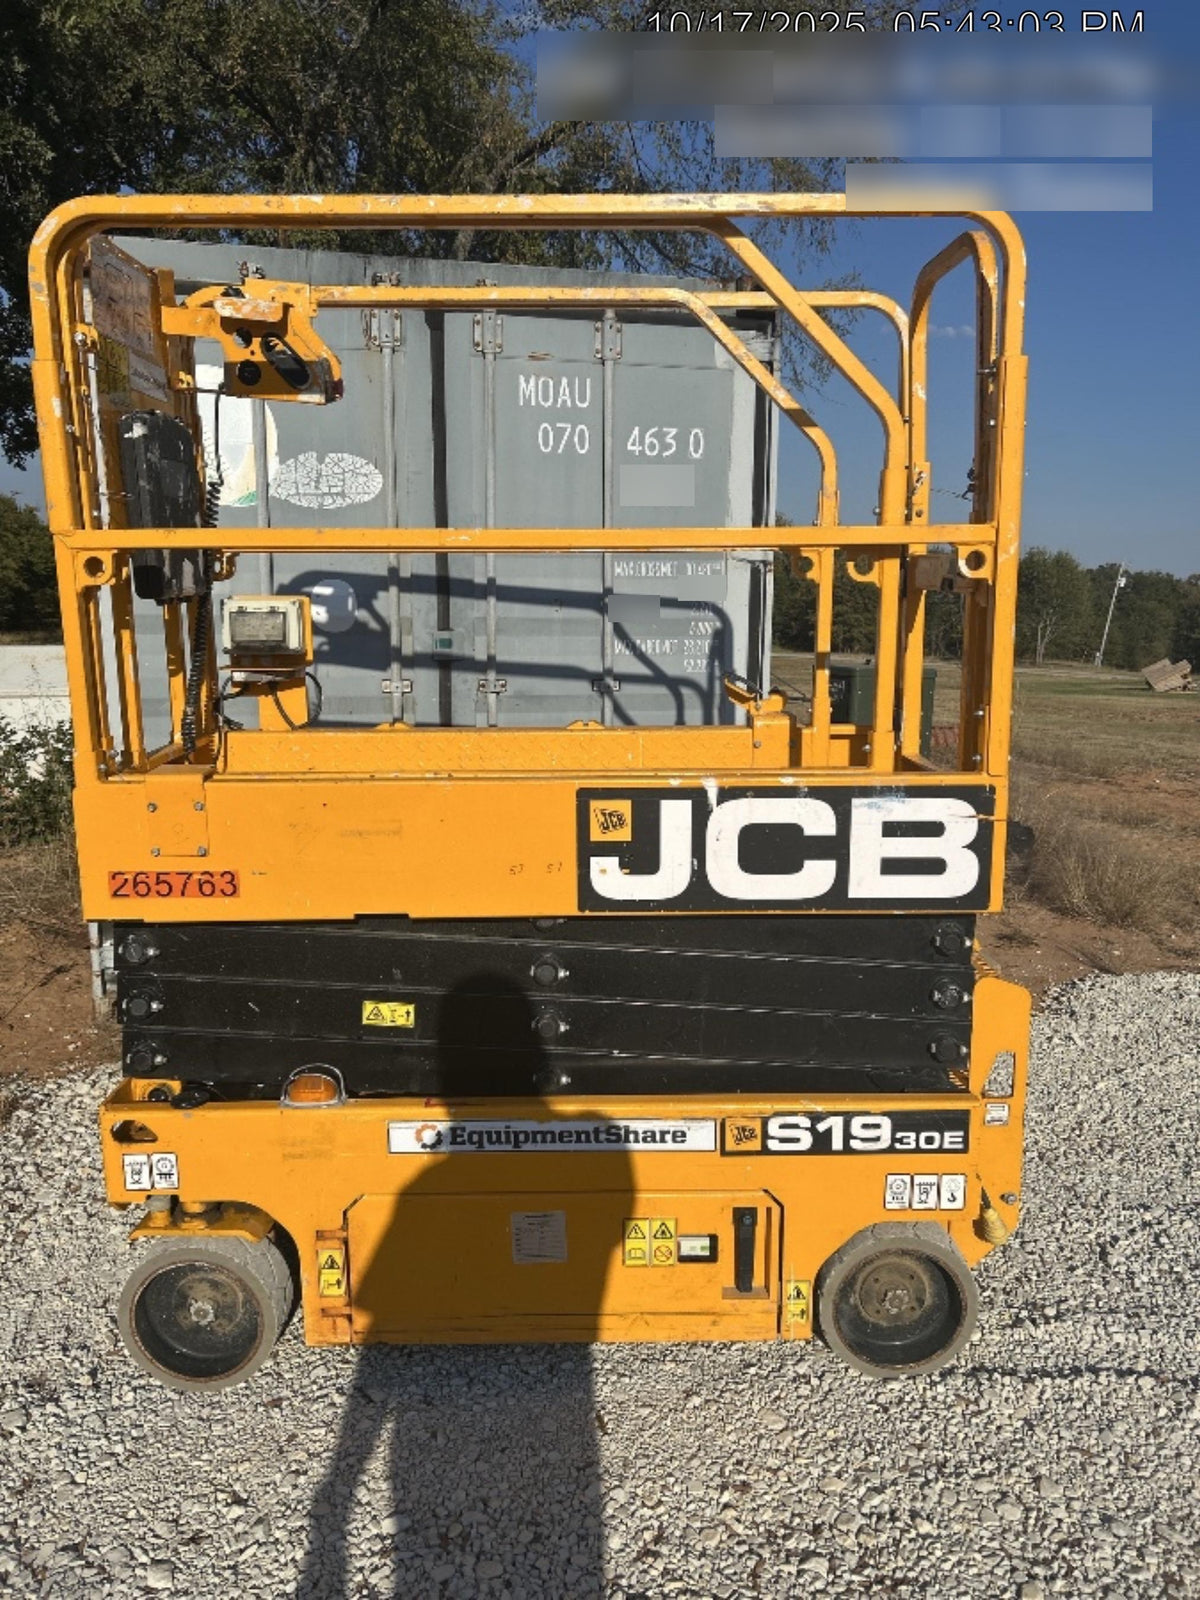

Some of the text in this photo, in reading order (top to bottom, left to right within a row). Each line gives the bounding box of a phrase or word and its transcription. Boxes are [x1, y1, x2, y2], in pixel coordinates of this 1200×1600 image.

[518, 374, 592, 408] MOAU
[538, 423, 704, 458] 070 463 0
[594, 807, 628, 834] JCB
[589, 797, 980, 900] JCB
[110, 871, 238, 898] 265763
[449, 1125, 688, 1149] EquipmentShare
